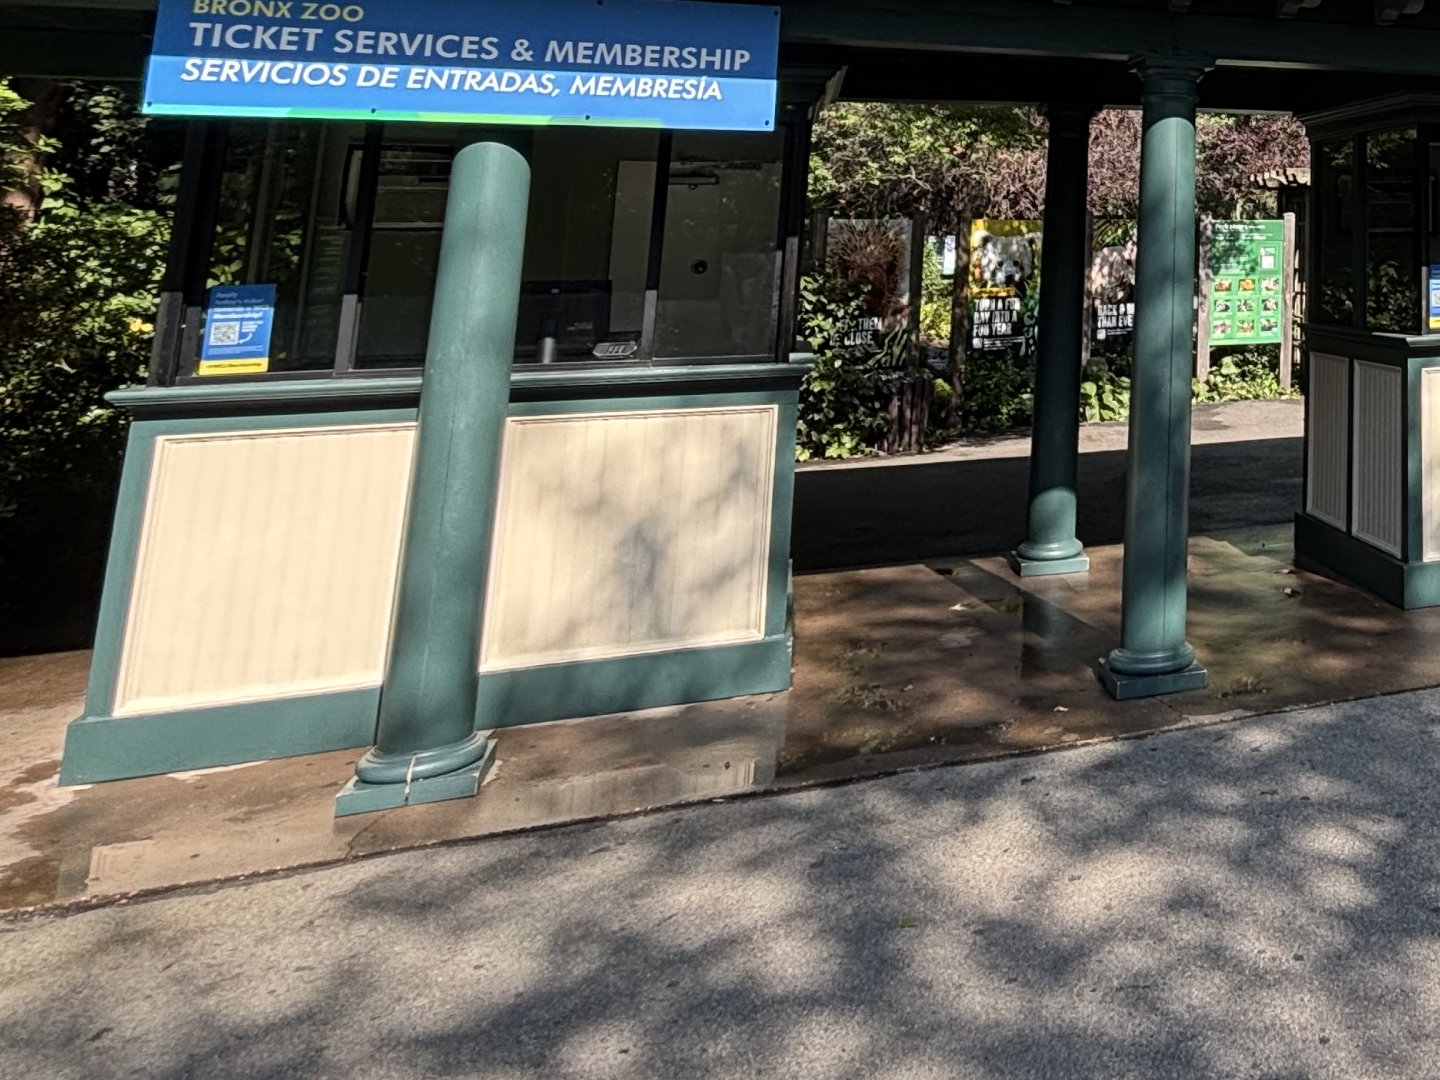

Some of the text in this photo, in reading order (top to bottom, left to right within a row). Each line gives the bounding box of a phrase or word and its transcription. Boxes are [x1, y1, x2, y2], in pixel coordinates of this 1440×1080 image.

[302, 3, 364, 23] ZOO
[189, 22, 752, 72] TICKET SERVICES & MEMBERSHIP
[181, 58, 723, 101] SERVICIOS DE ENTRADAS, MEMBRESÍA
[1012, 310, 1018, 322] A
[1118, 315, 1133, 327] EVE
[991, 322, 1012, 336] YEAR
